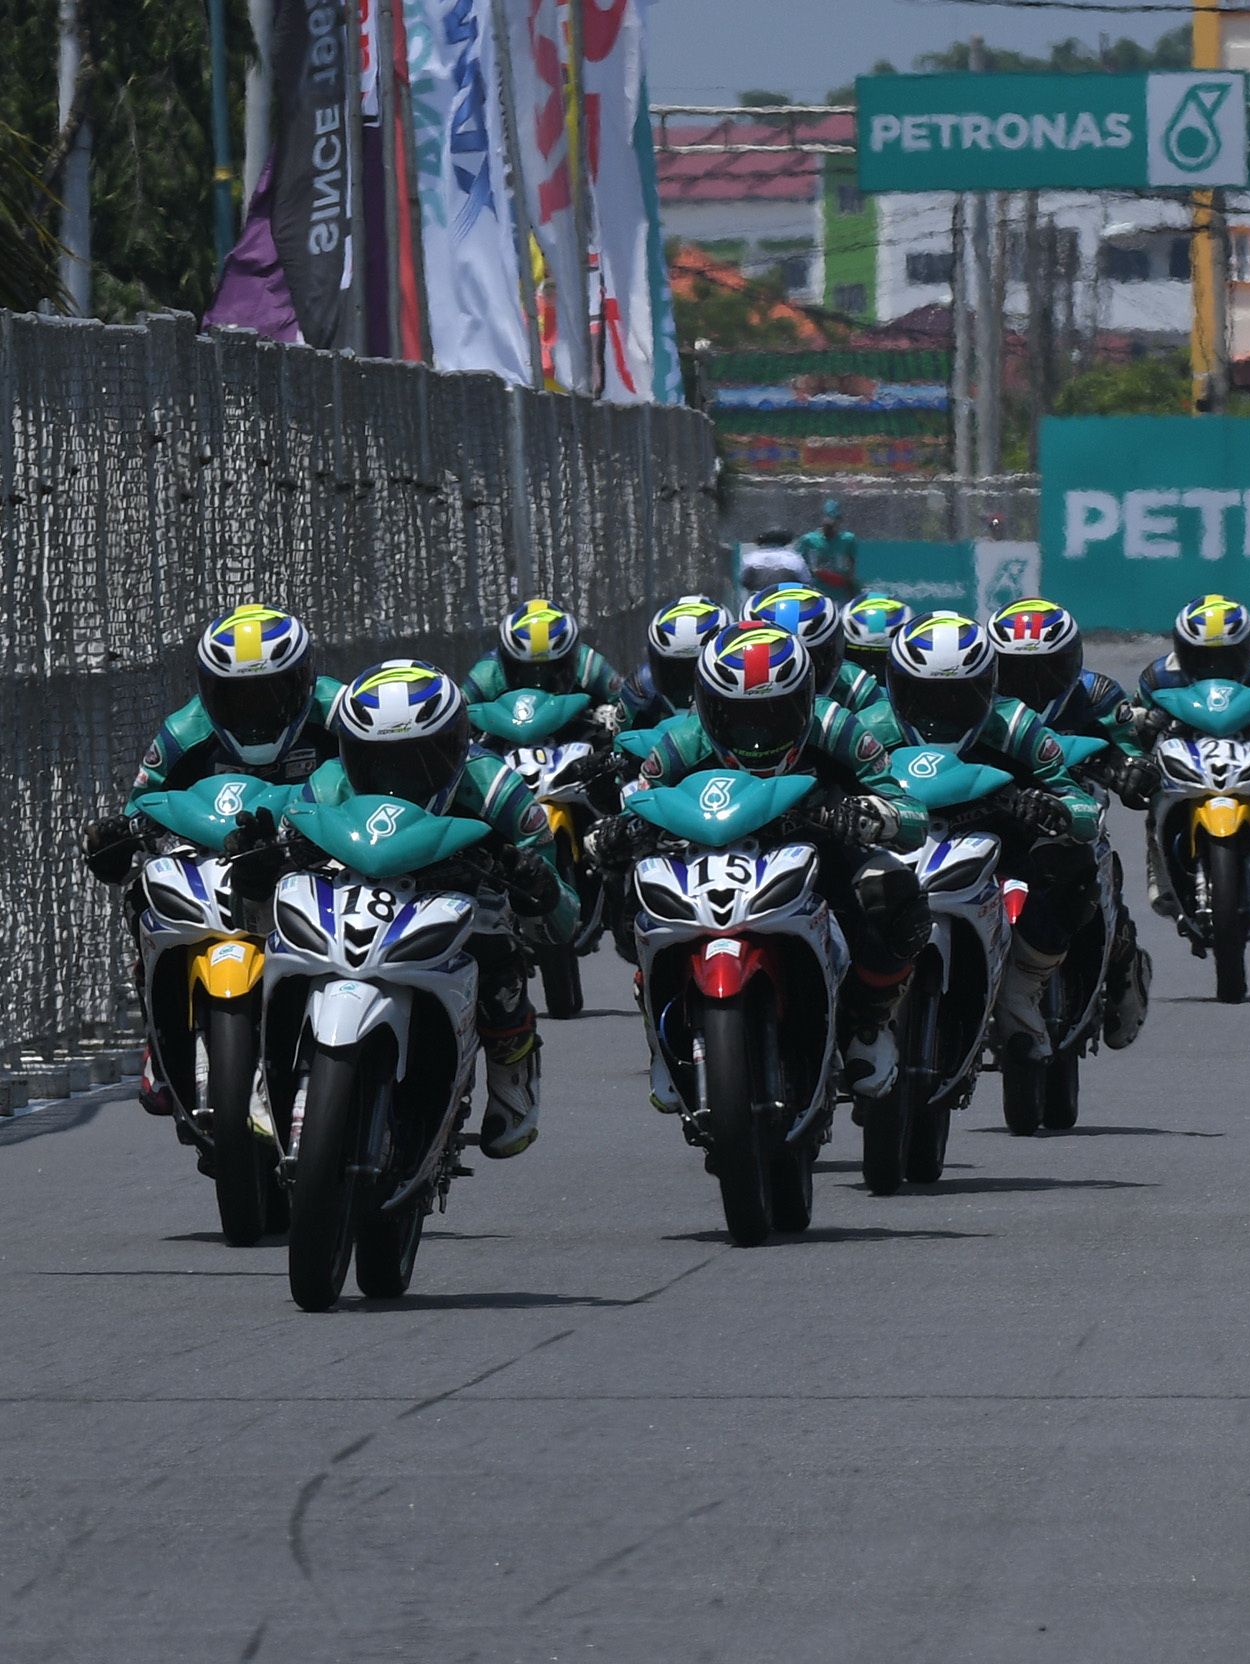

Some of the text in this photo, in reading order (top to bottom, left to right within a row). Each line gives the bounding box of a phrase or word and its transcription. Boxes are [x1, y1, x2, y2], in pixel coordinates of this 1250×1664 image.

[870, 112, 1132, 153] PETRONAS
[1200, 739, 1244, 766] 21
[693, 854, 753, 889] 15
[341, 884, 397, 923] 18
